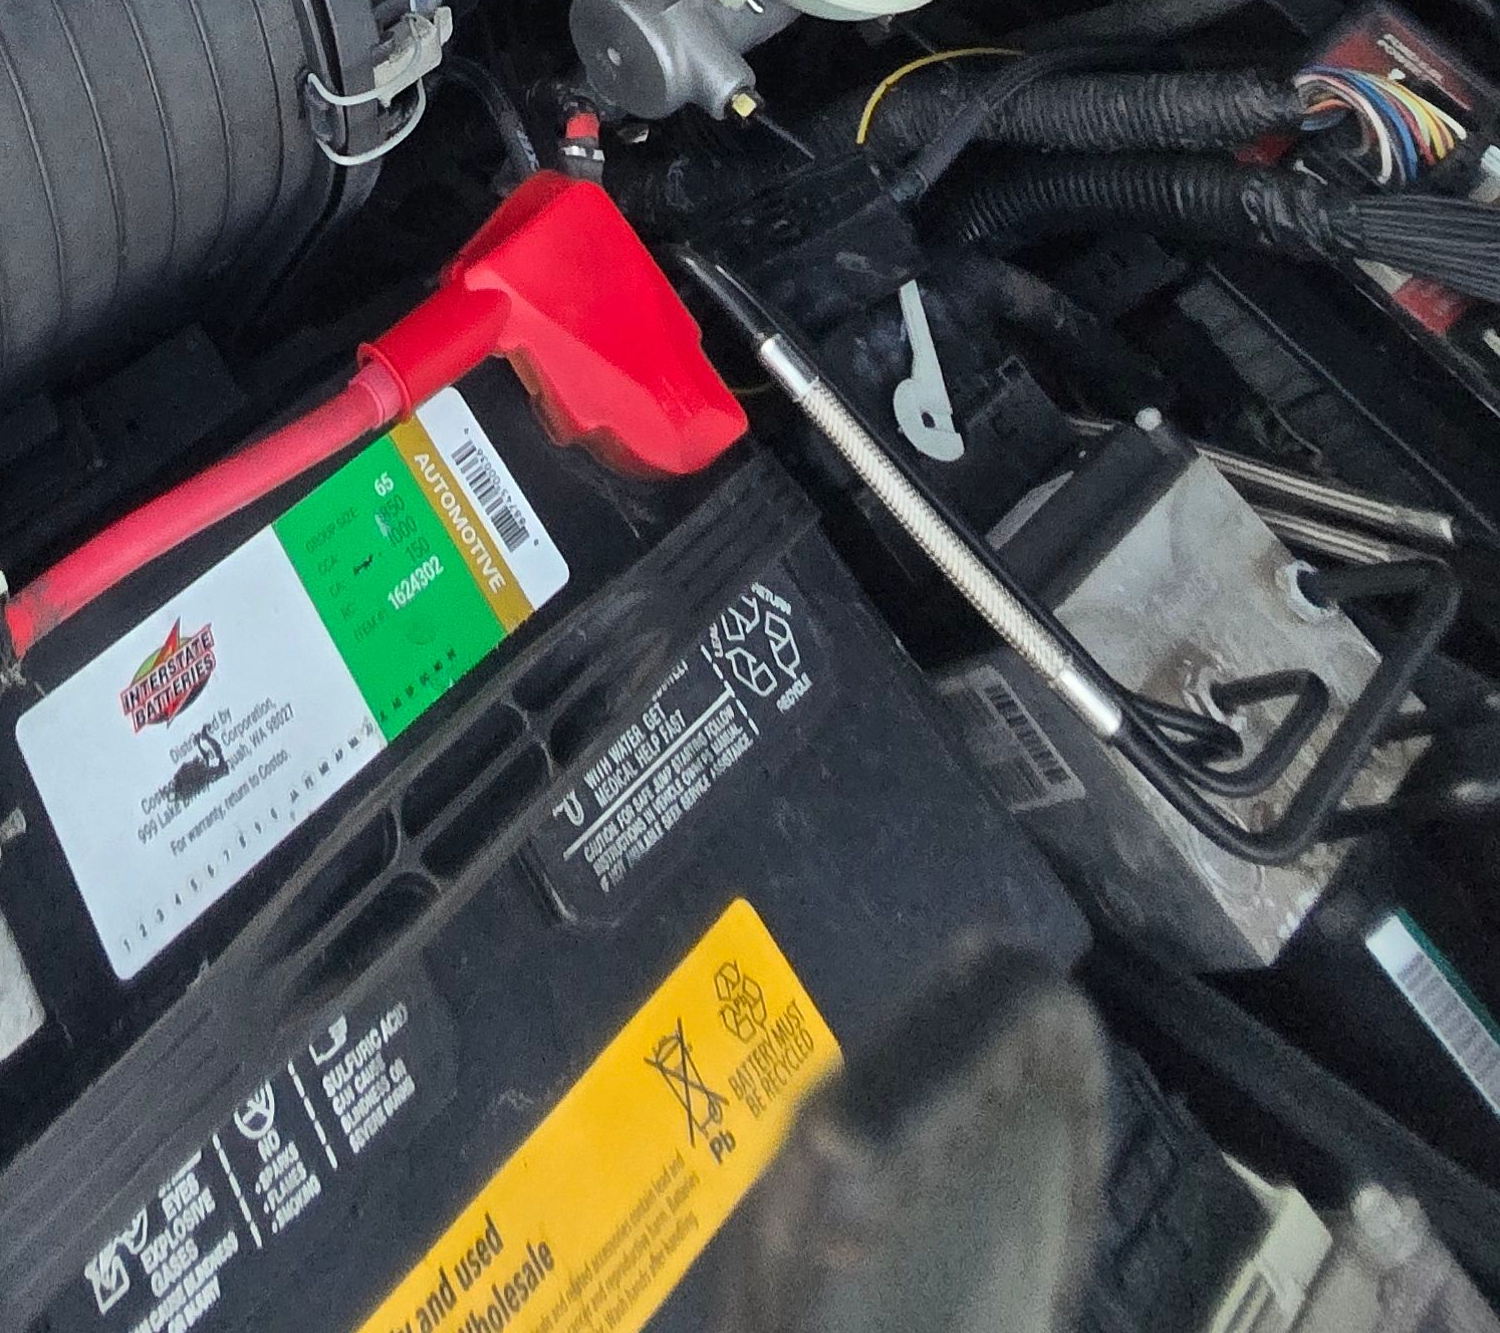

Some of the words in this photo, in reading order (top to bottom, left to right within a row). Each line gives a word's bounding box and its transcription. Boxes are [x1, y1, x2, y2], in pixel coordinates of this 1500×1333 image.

[374, 473, 393, 497] 65
[414, 452, 506, 593] AUTOMOTIVE
[388, 557, 444, 610] 1624302
[406, 537, 430, 565] 150
[120, 631, 211, 713] INTERSTATE
[134, 652, 215, 727] BATTERIES
[215, 707, 233, 723] by
[219, 696, 276, 747] Corporation,
[583, 757, 613, 790] WITH
[640, 701, 666, 731] GET
[135, 817, 159, 844] 999
[155, 800, 181, 828] Lake
[248, 726, 267, 747] WA
[265, 703, 293, 736] 98027
[594, 758, 639, 808] MEDICAL
[633, 733, 663, 768] HELP
[658, 708, 687, 743] FAST
[169, 835, 187, 856] For
[186, 803, 227, 841] warranty,
[223, 780, 250, 809] return
[247, 772, 260, 788] to
[630, 785, 654, 813] SAFE
[319, 1027, 384, 1098] SULFURIC
[377, 1001, 410, 1042] ACID
[728, 1027, 780, 1096] BATTERY
[774, 998, 809, 1052] MUST
[743, 1090, 764, 1119] BE
[760, 1030, 815, 1104] RECYCLED
[255, 1127, 283, 1162] NO
[708, 1130, 737, 1165] Pb
[138, 1186, 216, 1274] EXPLOSIVE
[158, 1171, 200, 1221] EYES
[146, 1236, 199, 1298] GASES
[415, 1265, 458, 1333] and
[454, 1211, 504, 1292] used
